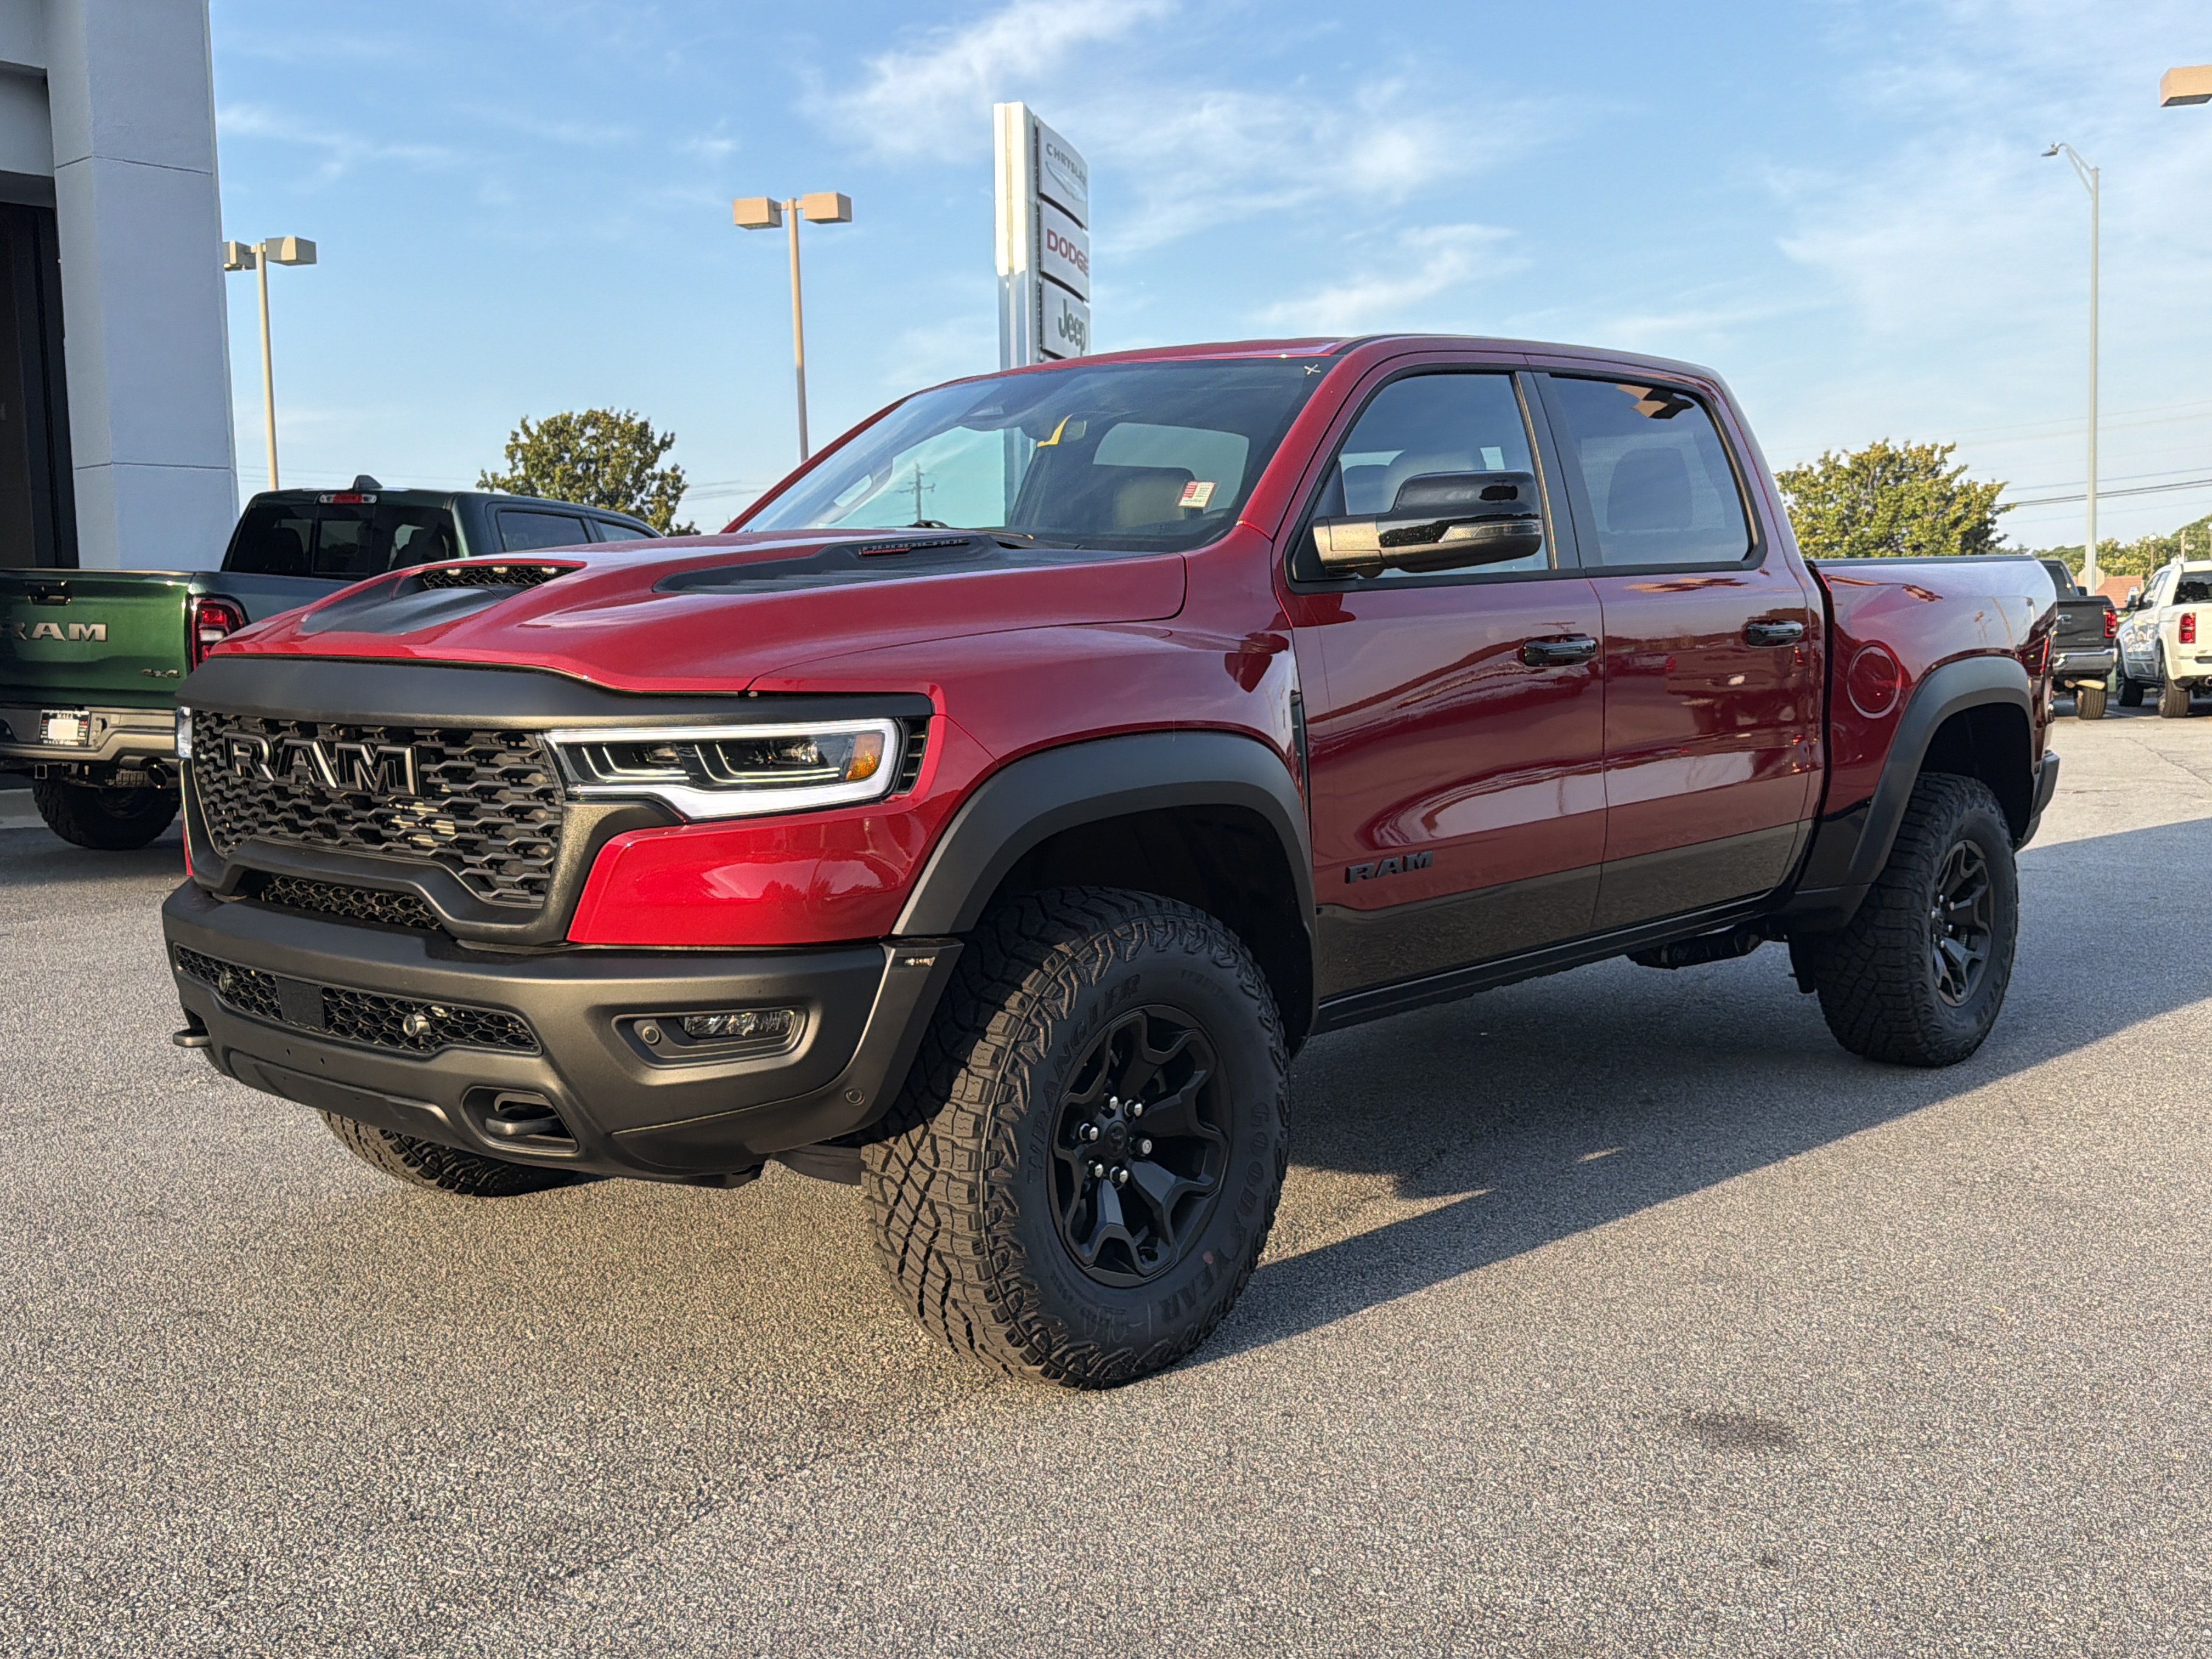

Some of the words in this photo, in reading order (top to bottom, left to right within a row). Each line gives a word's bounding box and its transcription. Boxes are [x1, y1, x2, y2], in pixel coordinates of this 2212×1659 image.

[1046, 143, 1087, 187] CHRYSLER
[1047, 228, 1088, 278] DODGE
[1058, 298, 1086, 357] Jeep
[222, 731, 421, 795] RAM
[1345, 851, 1433, 884] RAM
